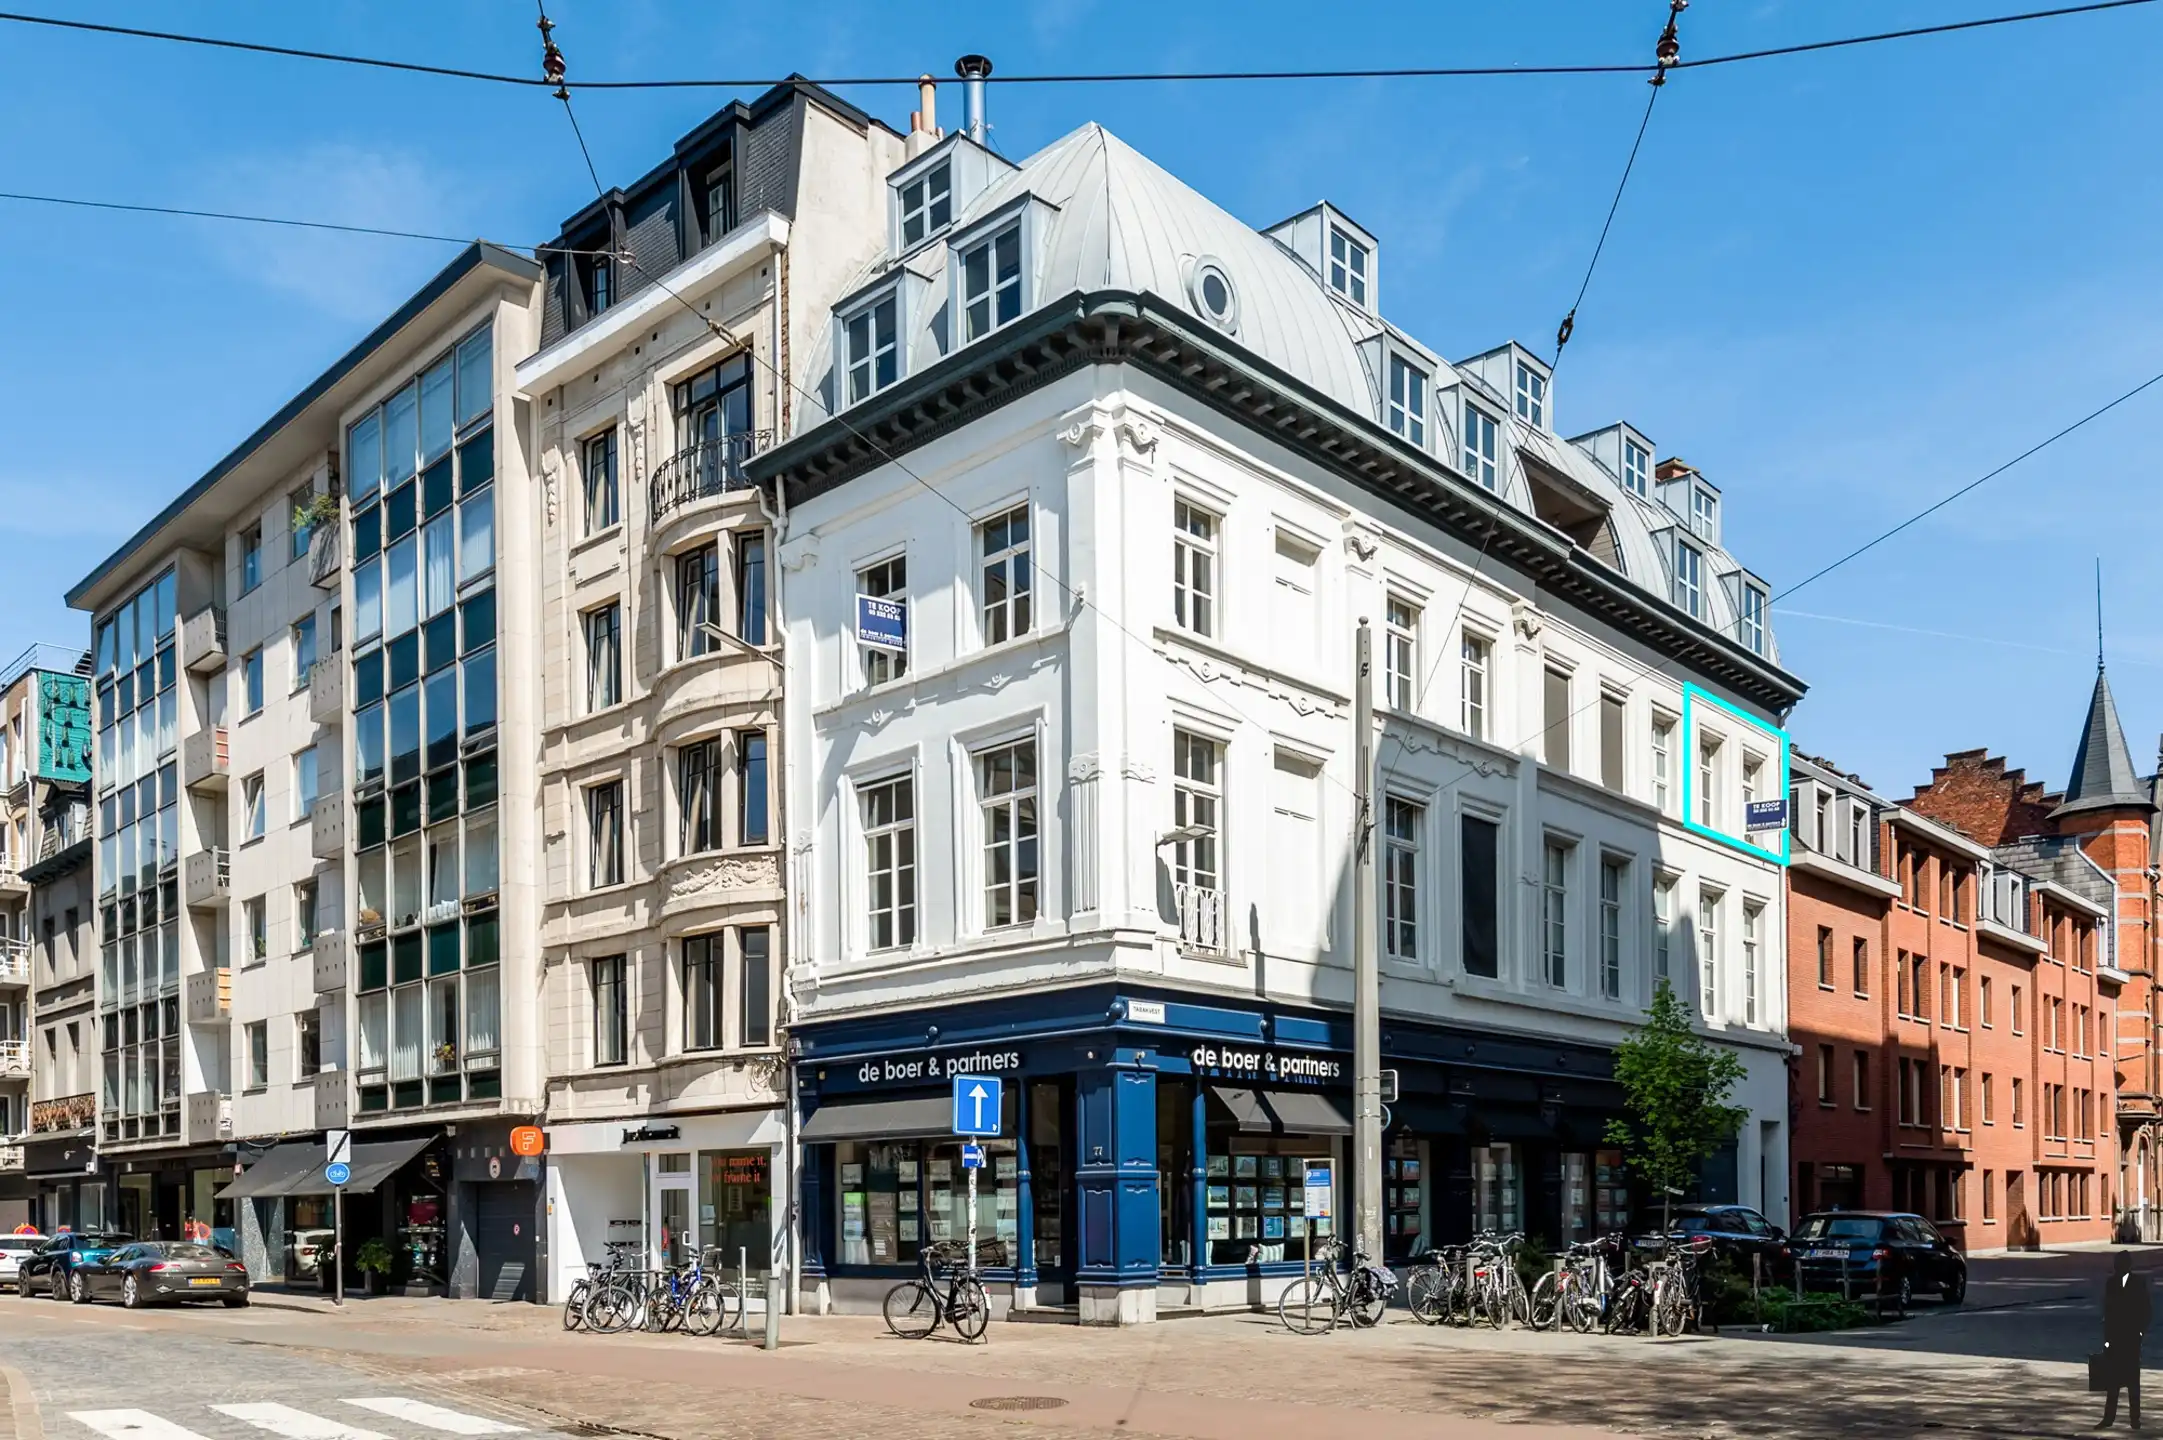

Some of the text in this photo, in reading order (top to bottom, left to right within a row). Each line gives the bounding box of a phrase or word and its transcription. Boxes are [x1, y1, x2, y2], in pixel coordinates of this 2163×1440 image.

[867, 601, 877, 610] TE
[858, 1050, 1020, 1083] de boer & partners
[1193, 1045, 1340, 1078] de boer & partners
